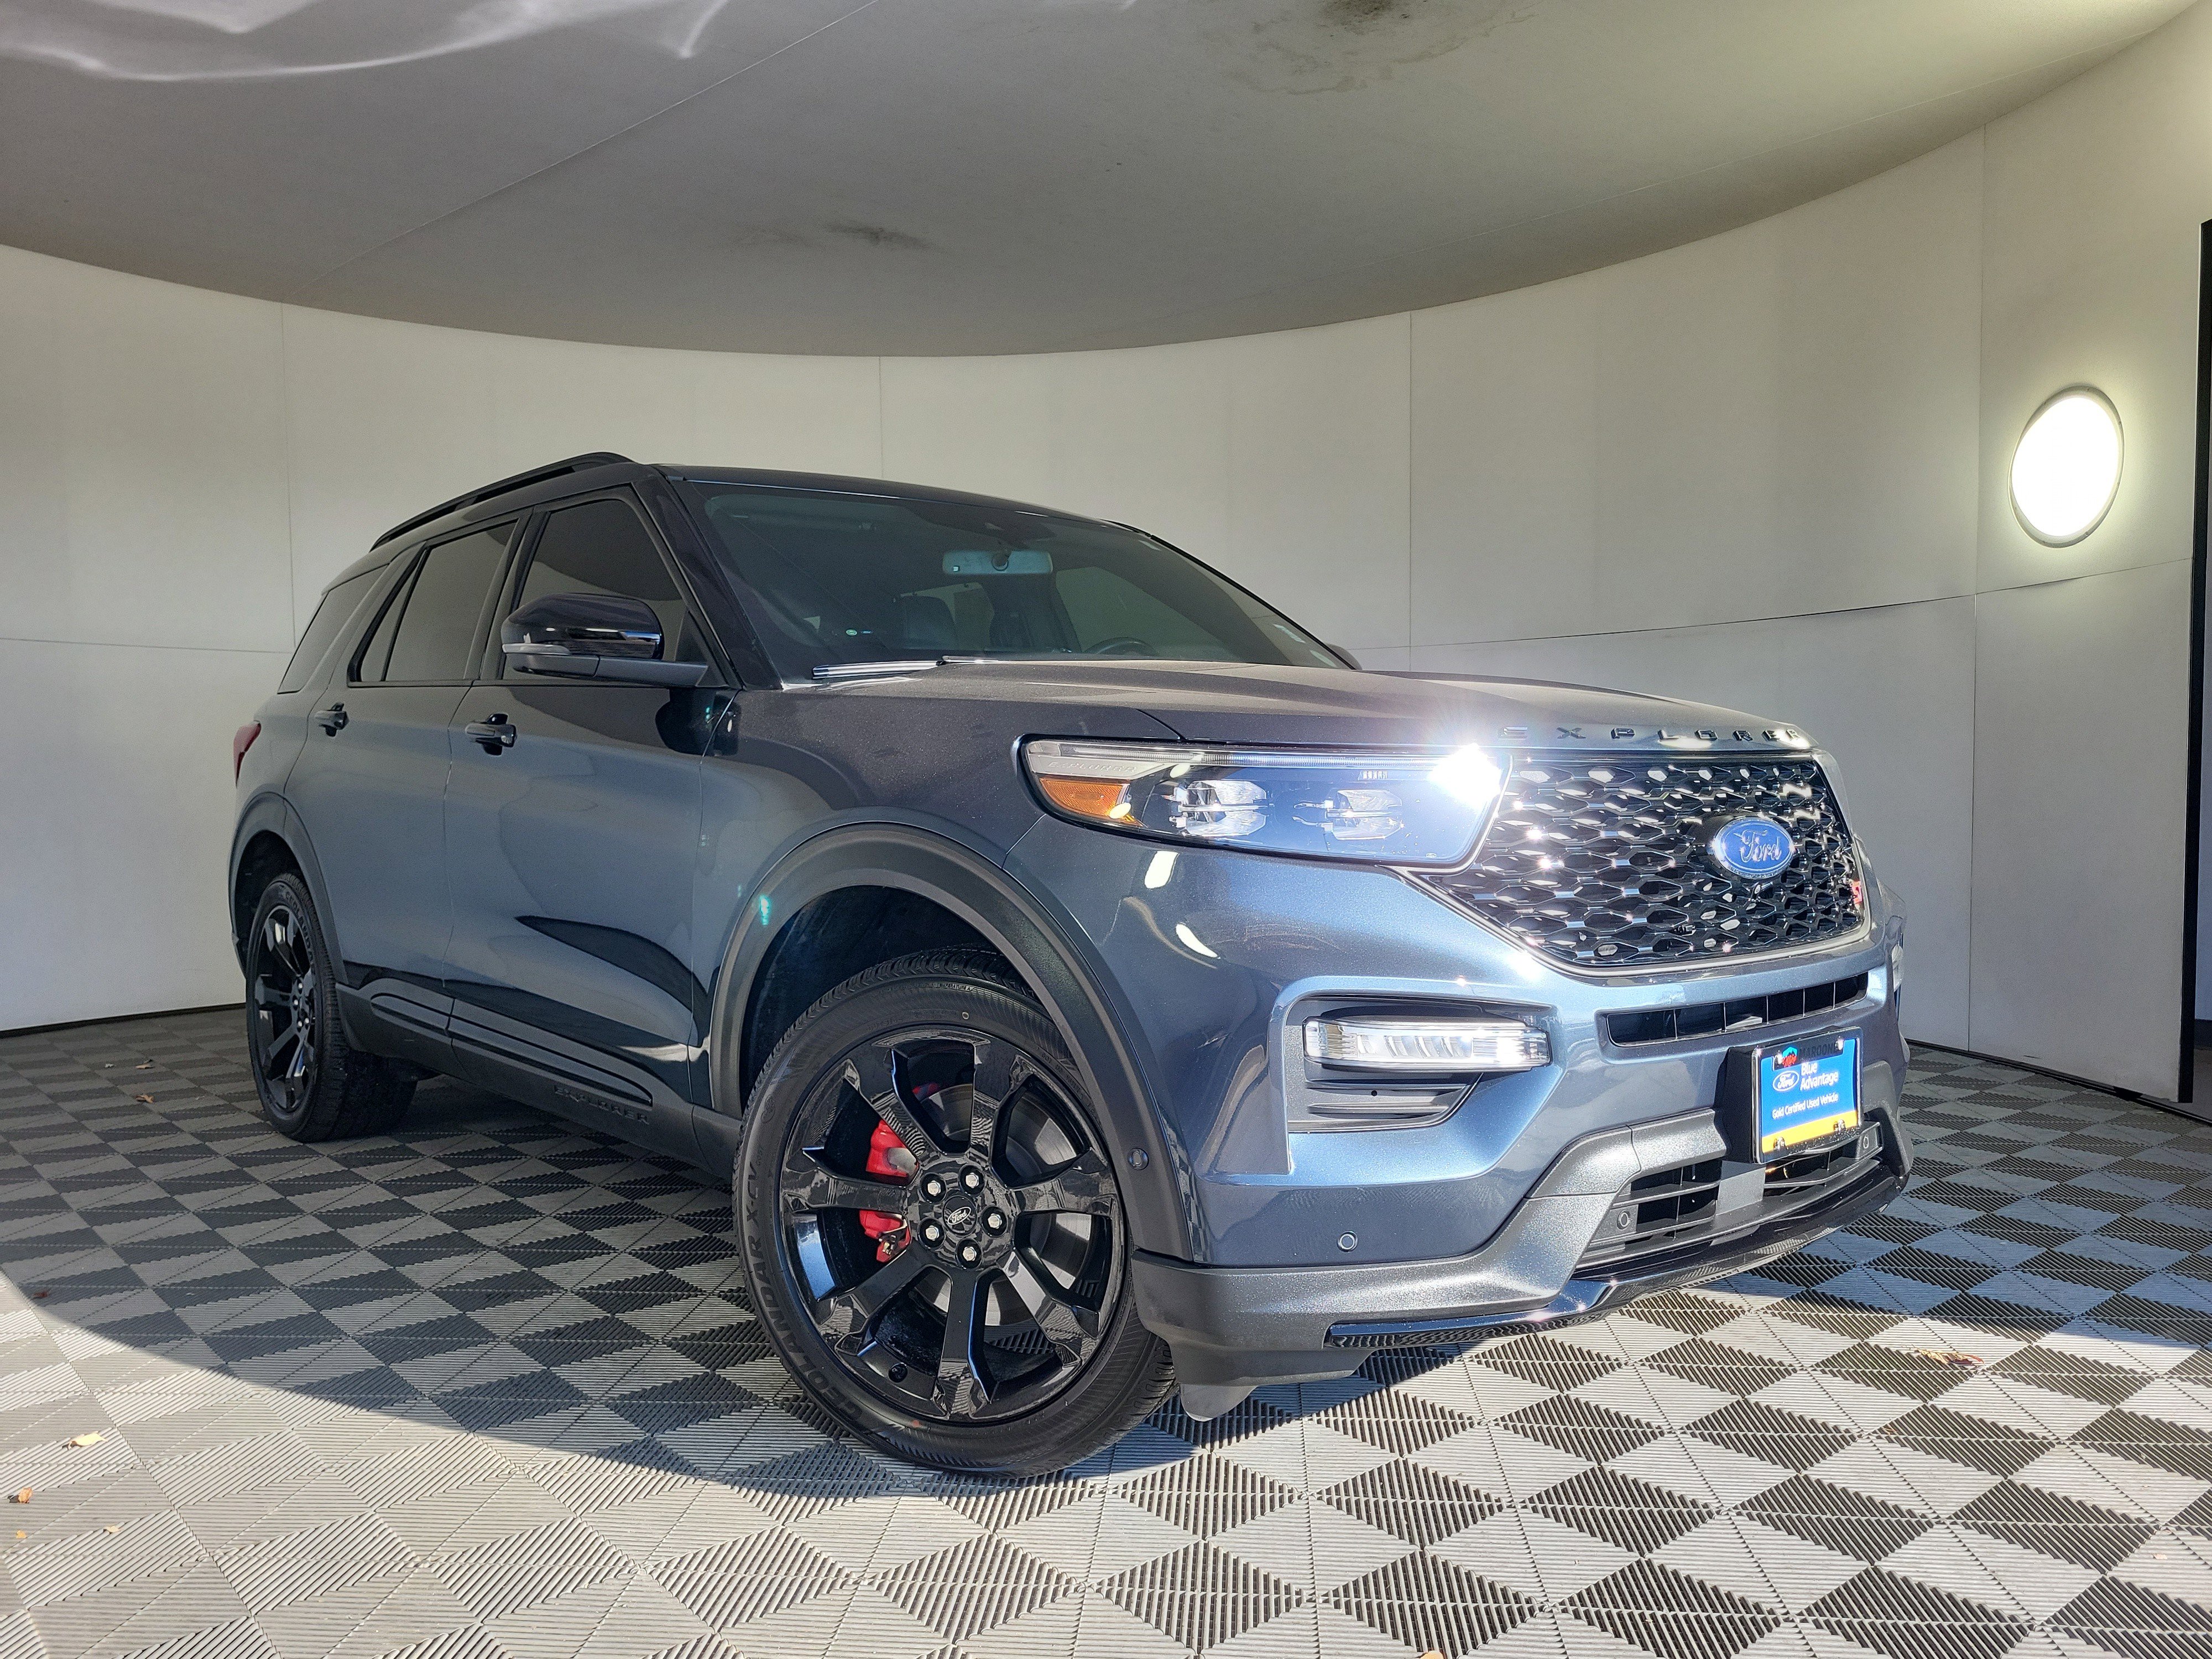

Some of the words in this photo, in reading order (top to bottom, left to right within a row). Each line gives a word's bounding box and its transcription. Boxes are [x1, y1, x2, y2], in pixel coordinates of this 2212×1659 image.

[1498, 726, 1801, 742] EXPLORER
[1734, 830, 1782, 863] Ford
[1801, 1062, 1818, 1076] Blue
[1777, 1073, 1795, 1089] Ford
[1800, 1071, 1839, 1091] Advantage
[1772, 1106, 1785, 1119] Gold
[1785, 1100, 1806, 1115] Certified
[1807, 1097, 1820, 1109] Used
[1820, 1092, 1839, 1105] Vehicle
[746, 1162, 759, 1228] X-CV
[950, 1209, 967, 1223] Ford
[748, 1234, 863, 1421] GEOLANDAR
